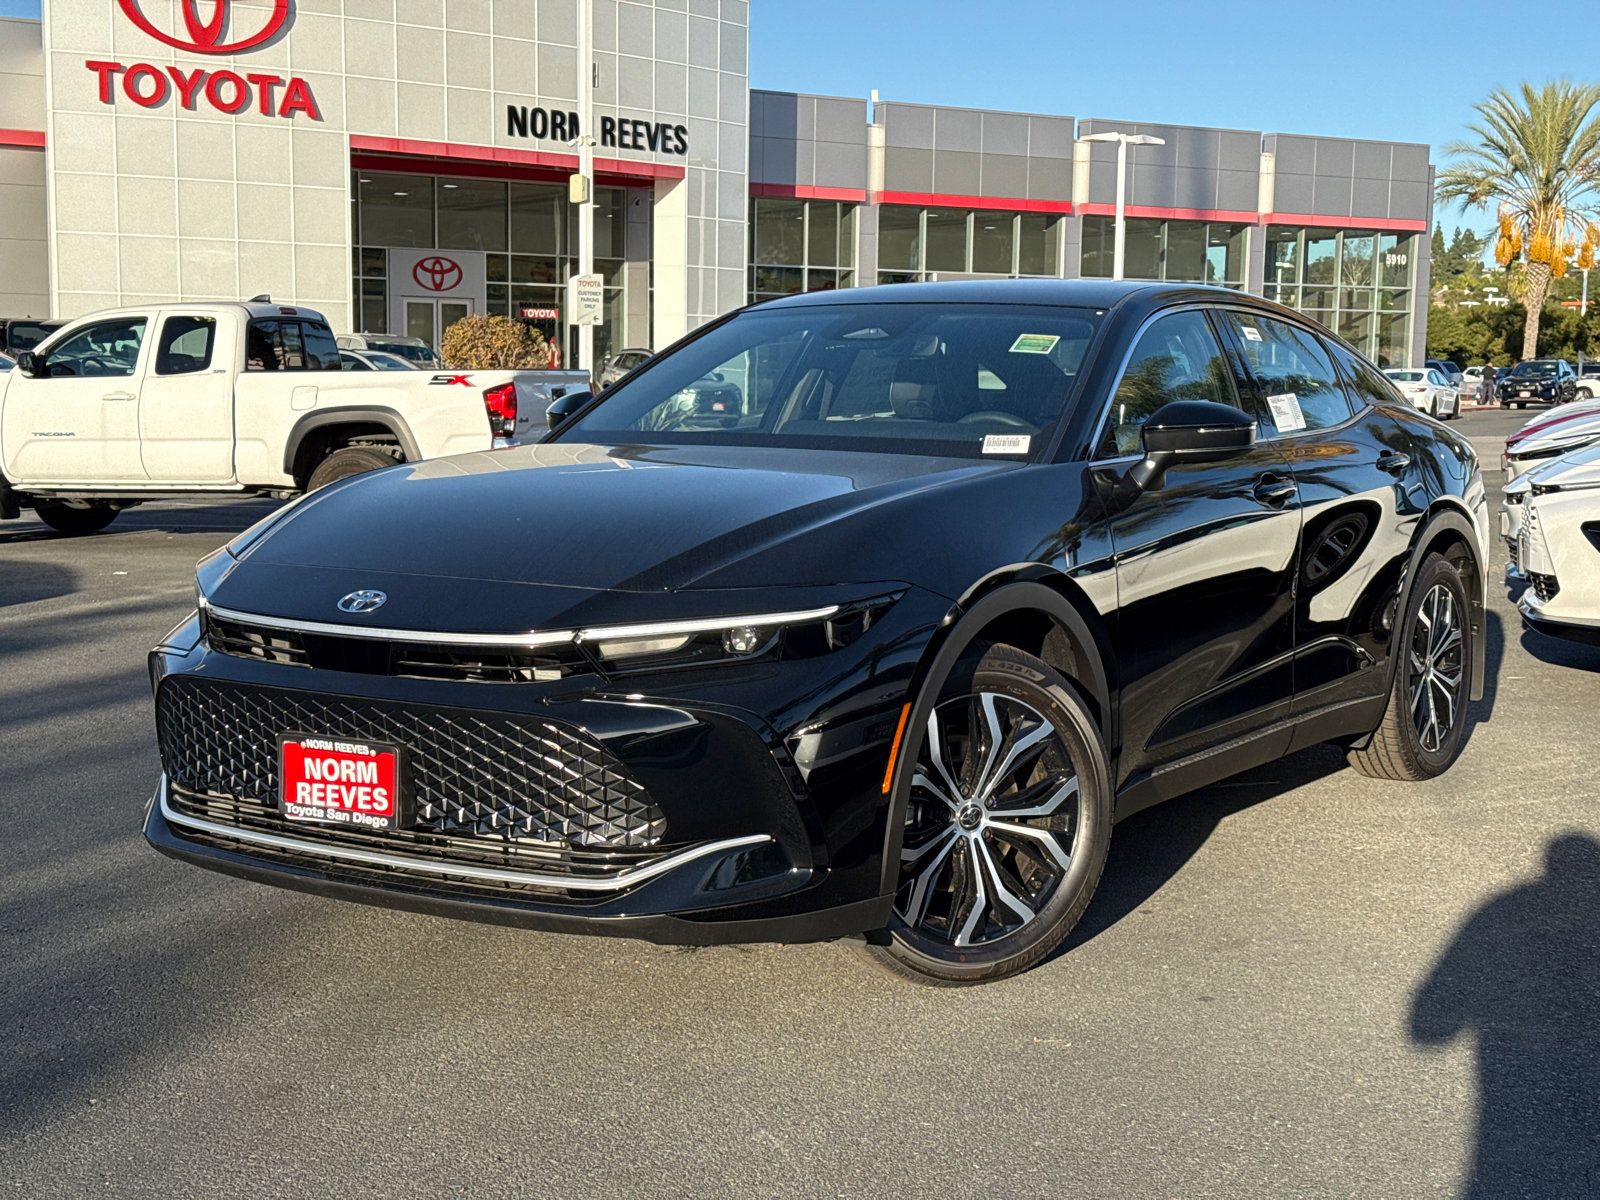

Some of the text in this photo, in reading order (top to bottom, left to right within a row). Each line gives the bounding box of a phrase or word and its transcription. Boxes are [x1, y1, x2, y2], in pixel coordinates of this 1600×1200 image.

[85, 60, 319, 119] TOYOTA
[601, 116, 688, 155] REEVES
[1385, 253, 1407, 266] 5910
[523, 309, 556, 318] TOYOTA
[305, 739, 370, 756] NORM REEVES
[303, 757, 379, 785] NORM
[296, 781, 390, 812] REEVES
[284, 802, 389, 829] Toyota San Diego
